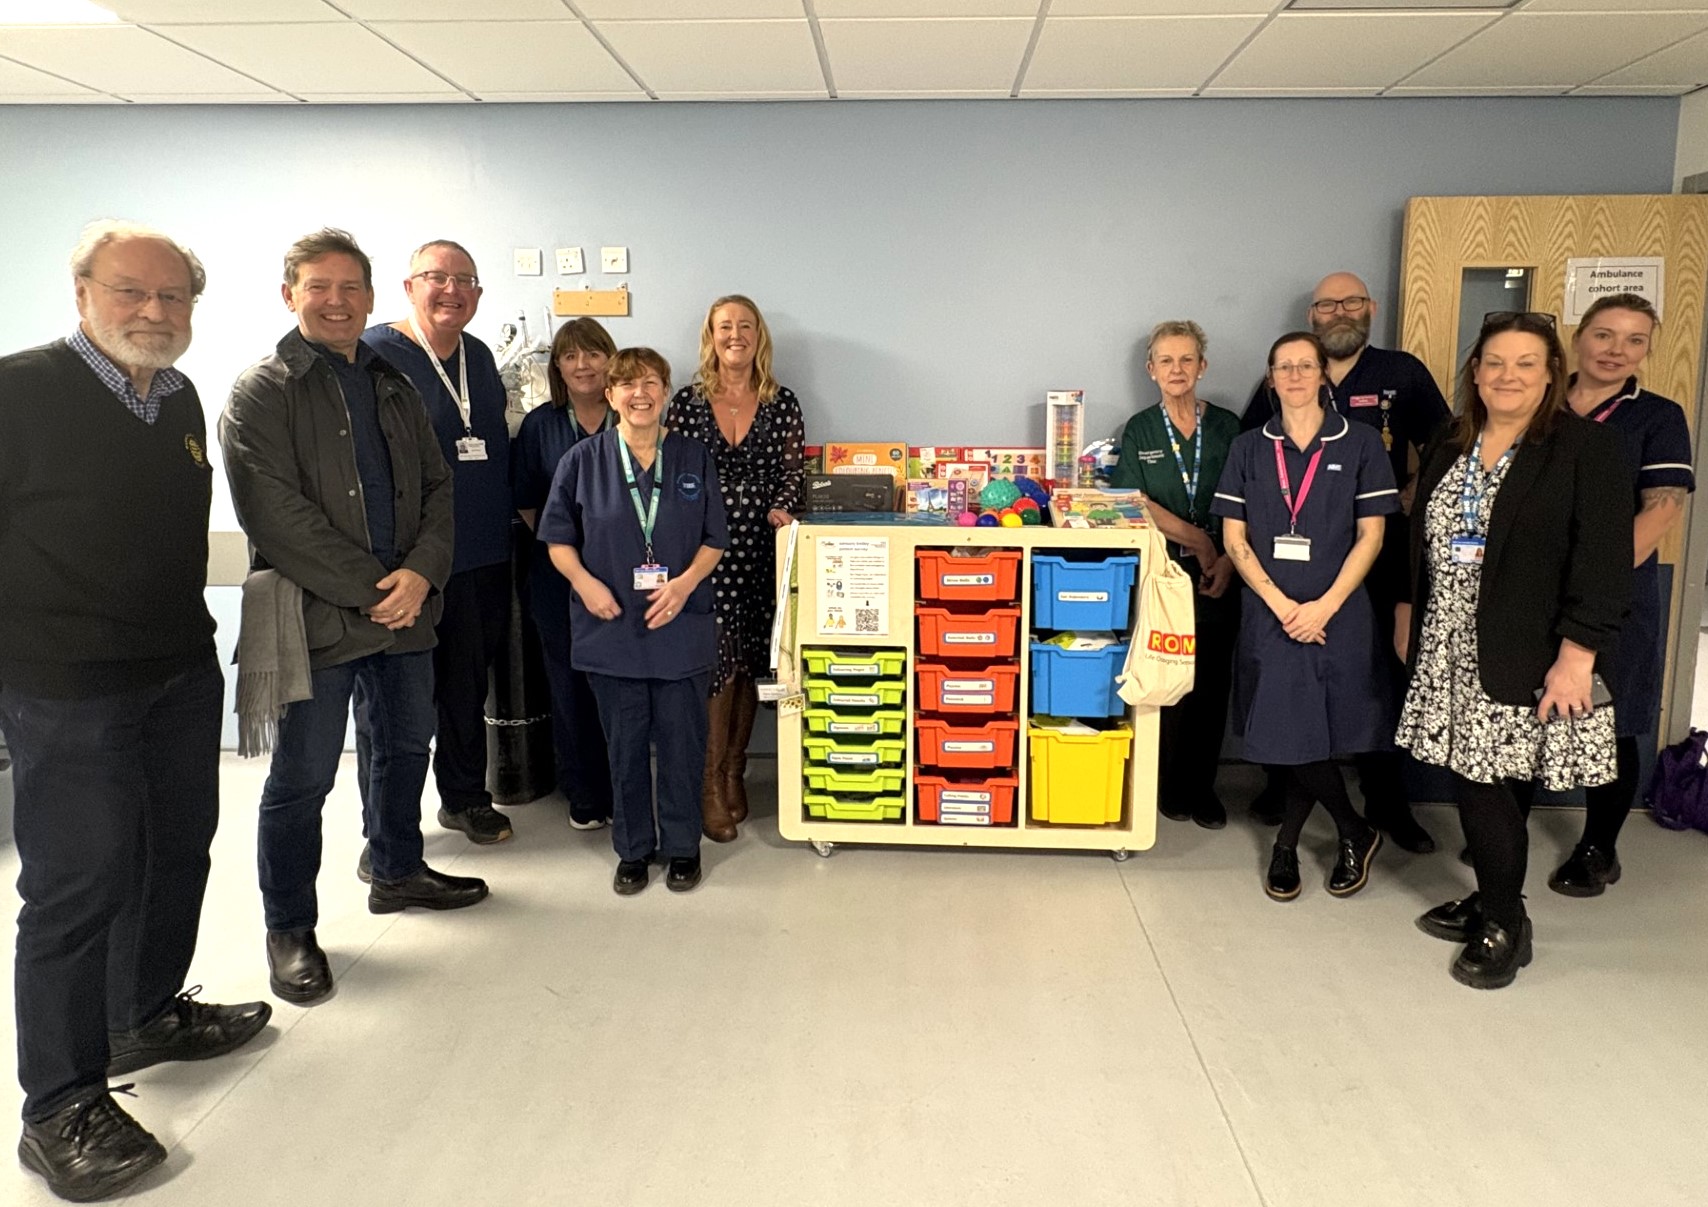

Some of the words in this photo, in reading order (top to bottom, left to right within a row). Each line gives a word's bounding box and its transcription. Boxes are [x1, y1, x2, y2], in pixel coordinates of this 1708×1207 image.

[1590, 269, 1643, 279] Ambulance
[1588, 285, 1620, 293] cohort
[1002, 455, 1012, 463] 2
[1016, 455, 1026, 463] 3
